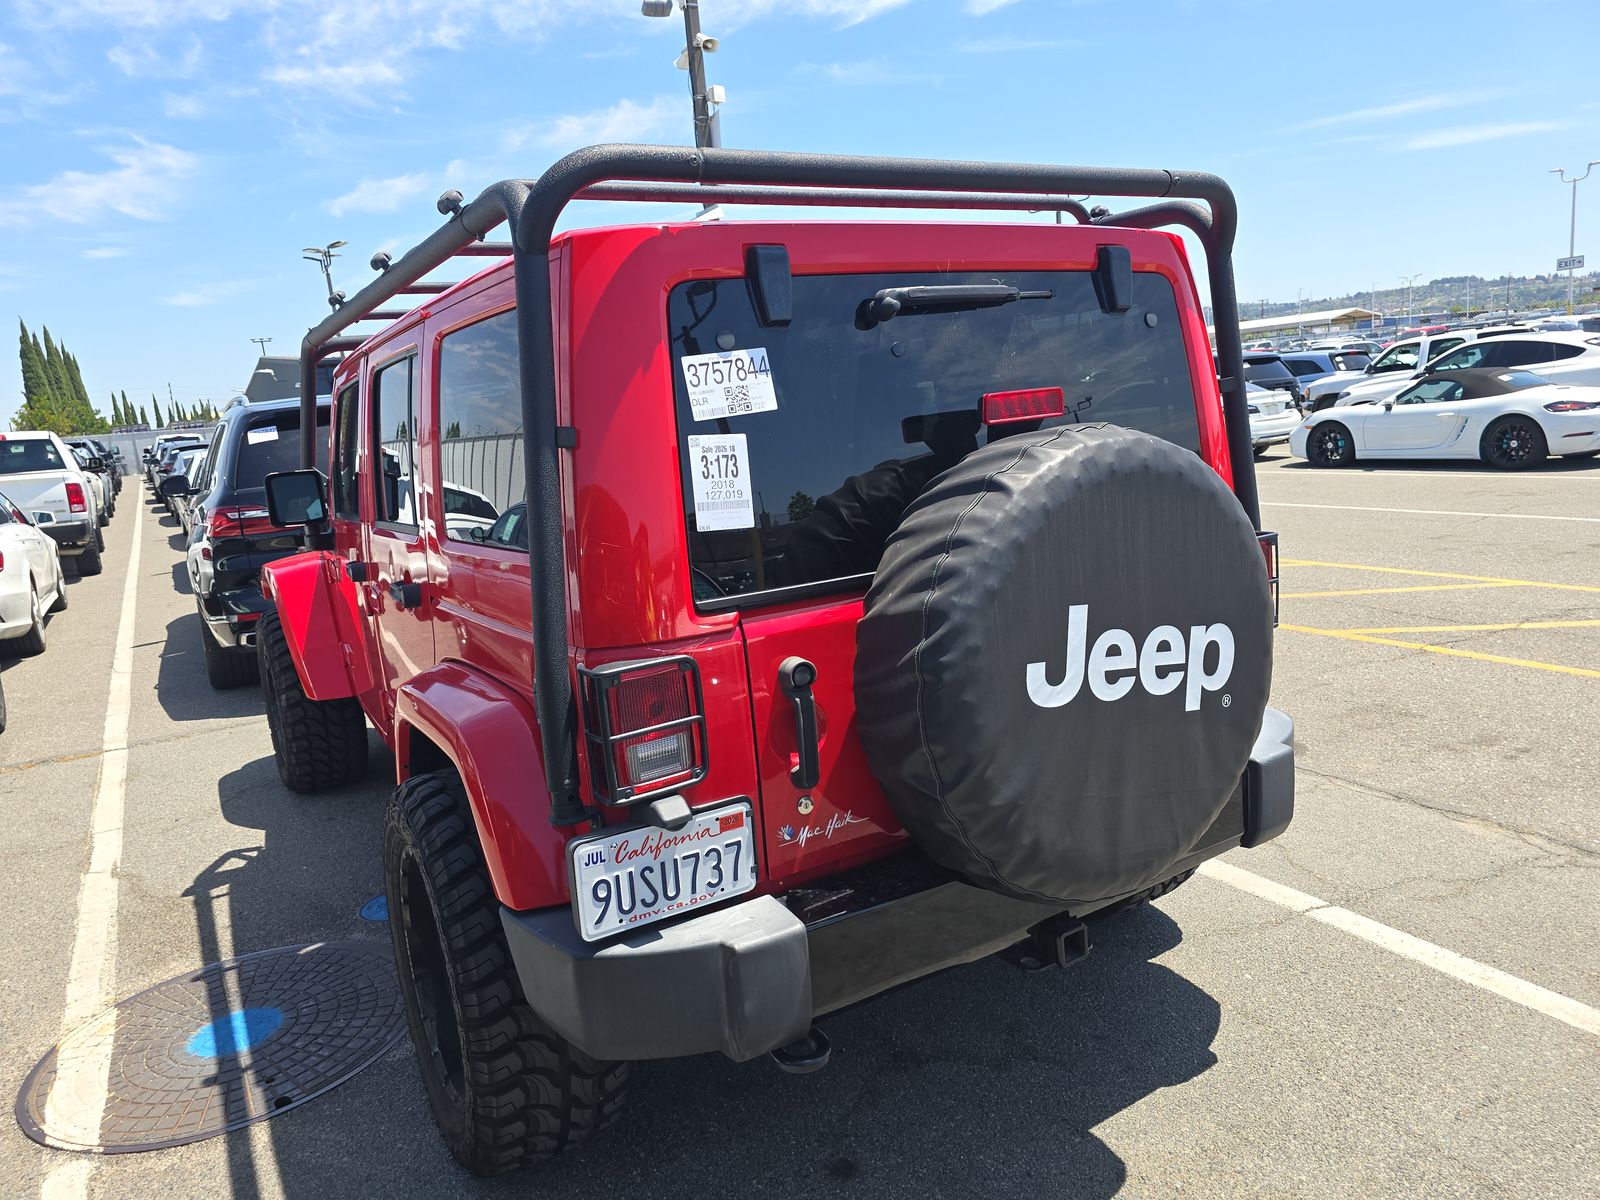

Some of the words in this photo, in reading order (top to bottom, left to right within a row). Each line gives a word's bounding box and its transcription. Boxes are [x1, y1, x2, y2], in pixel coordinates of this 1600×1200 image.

[1558, 260, 1576, 268] EXIT
[687, 356, 770, 388] 3757844
[692, 397, 709, 407] DLR
[702, 446, 713, 454] Sale
[701, 454, 739, 480] 3:173
[705, 490, 743, 501] 127,019
[711, 480, 735, 490] 2018
[1026, 604, 1236, 712] Jeep
[778, 825, 825, 848] Mac
[824, 809, 870, 839] Haik
[615, 822, 722, 865] California
[584, 851, 606, 867] JUL
[591, 839, 743, 926] 9USU737
[628, 891, 717, 923] dmv.ca.gov
